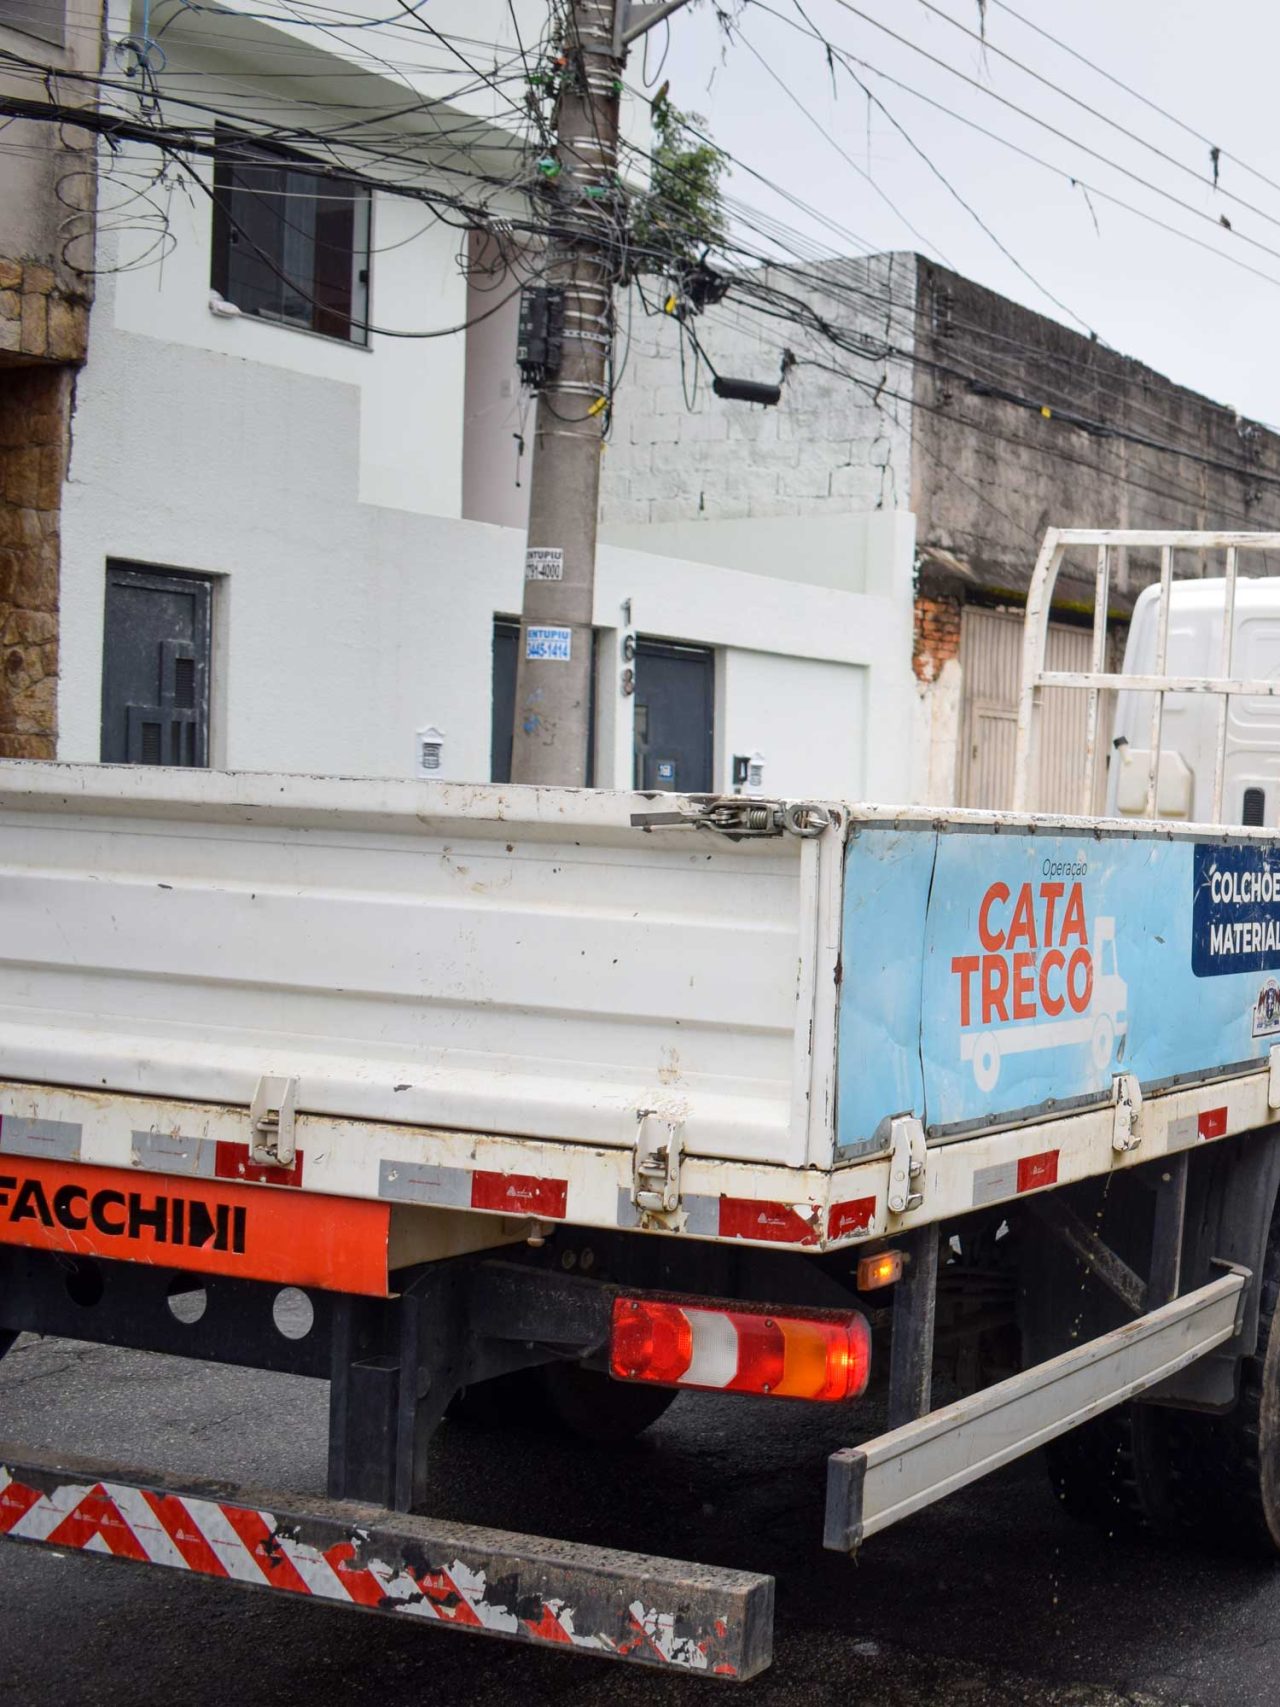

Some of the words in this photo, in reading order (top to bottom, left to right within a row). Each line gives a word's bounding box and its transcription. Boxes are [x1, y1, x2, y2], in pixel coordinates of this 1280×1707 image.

[1042, 858, 1088, 880] Operação
[978, 881, 1088, 953] CATA
[951, 947, 1093, 1027] TRECO
